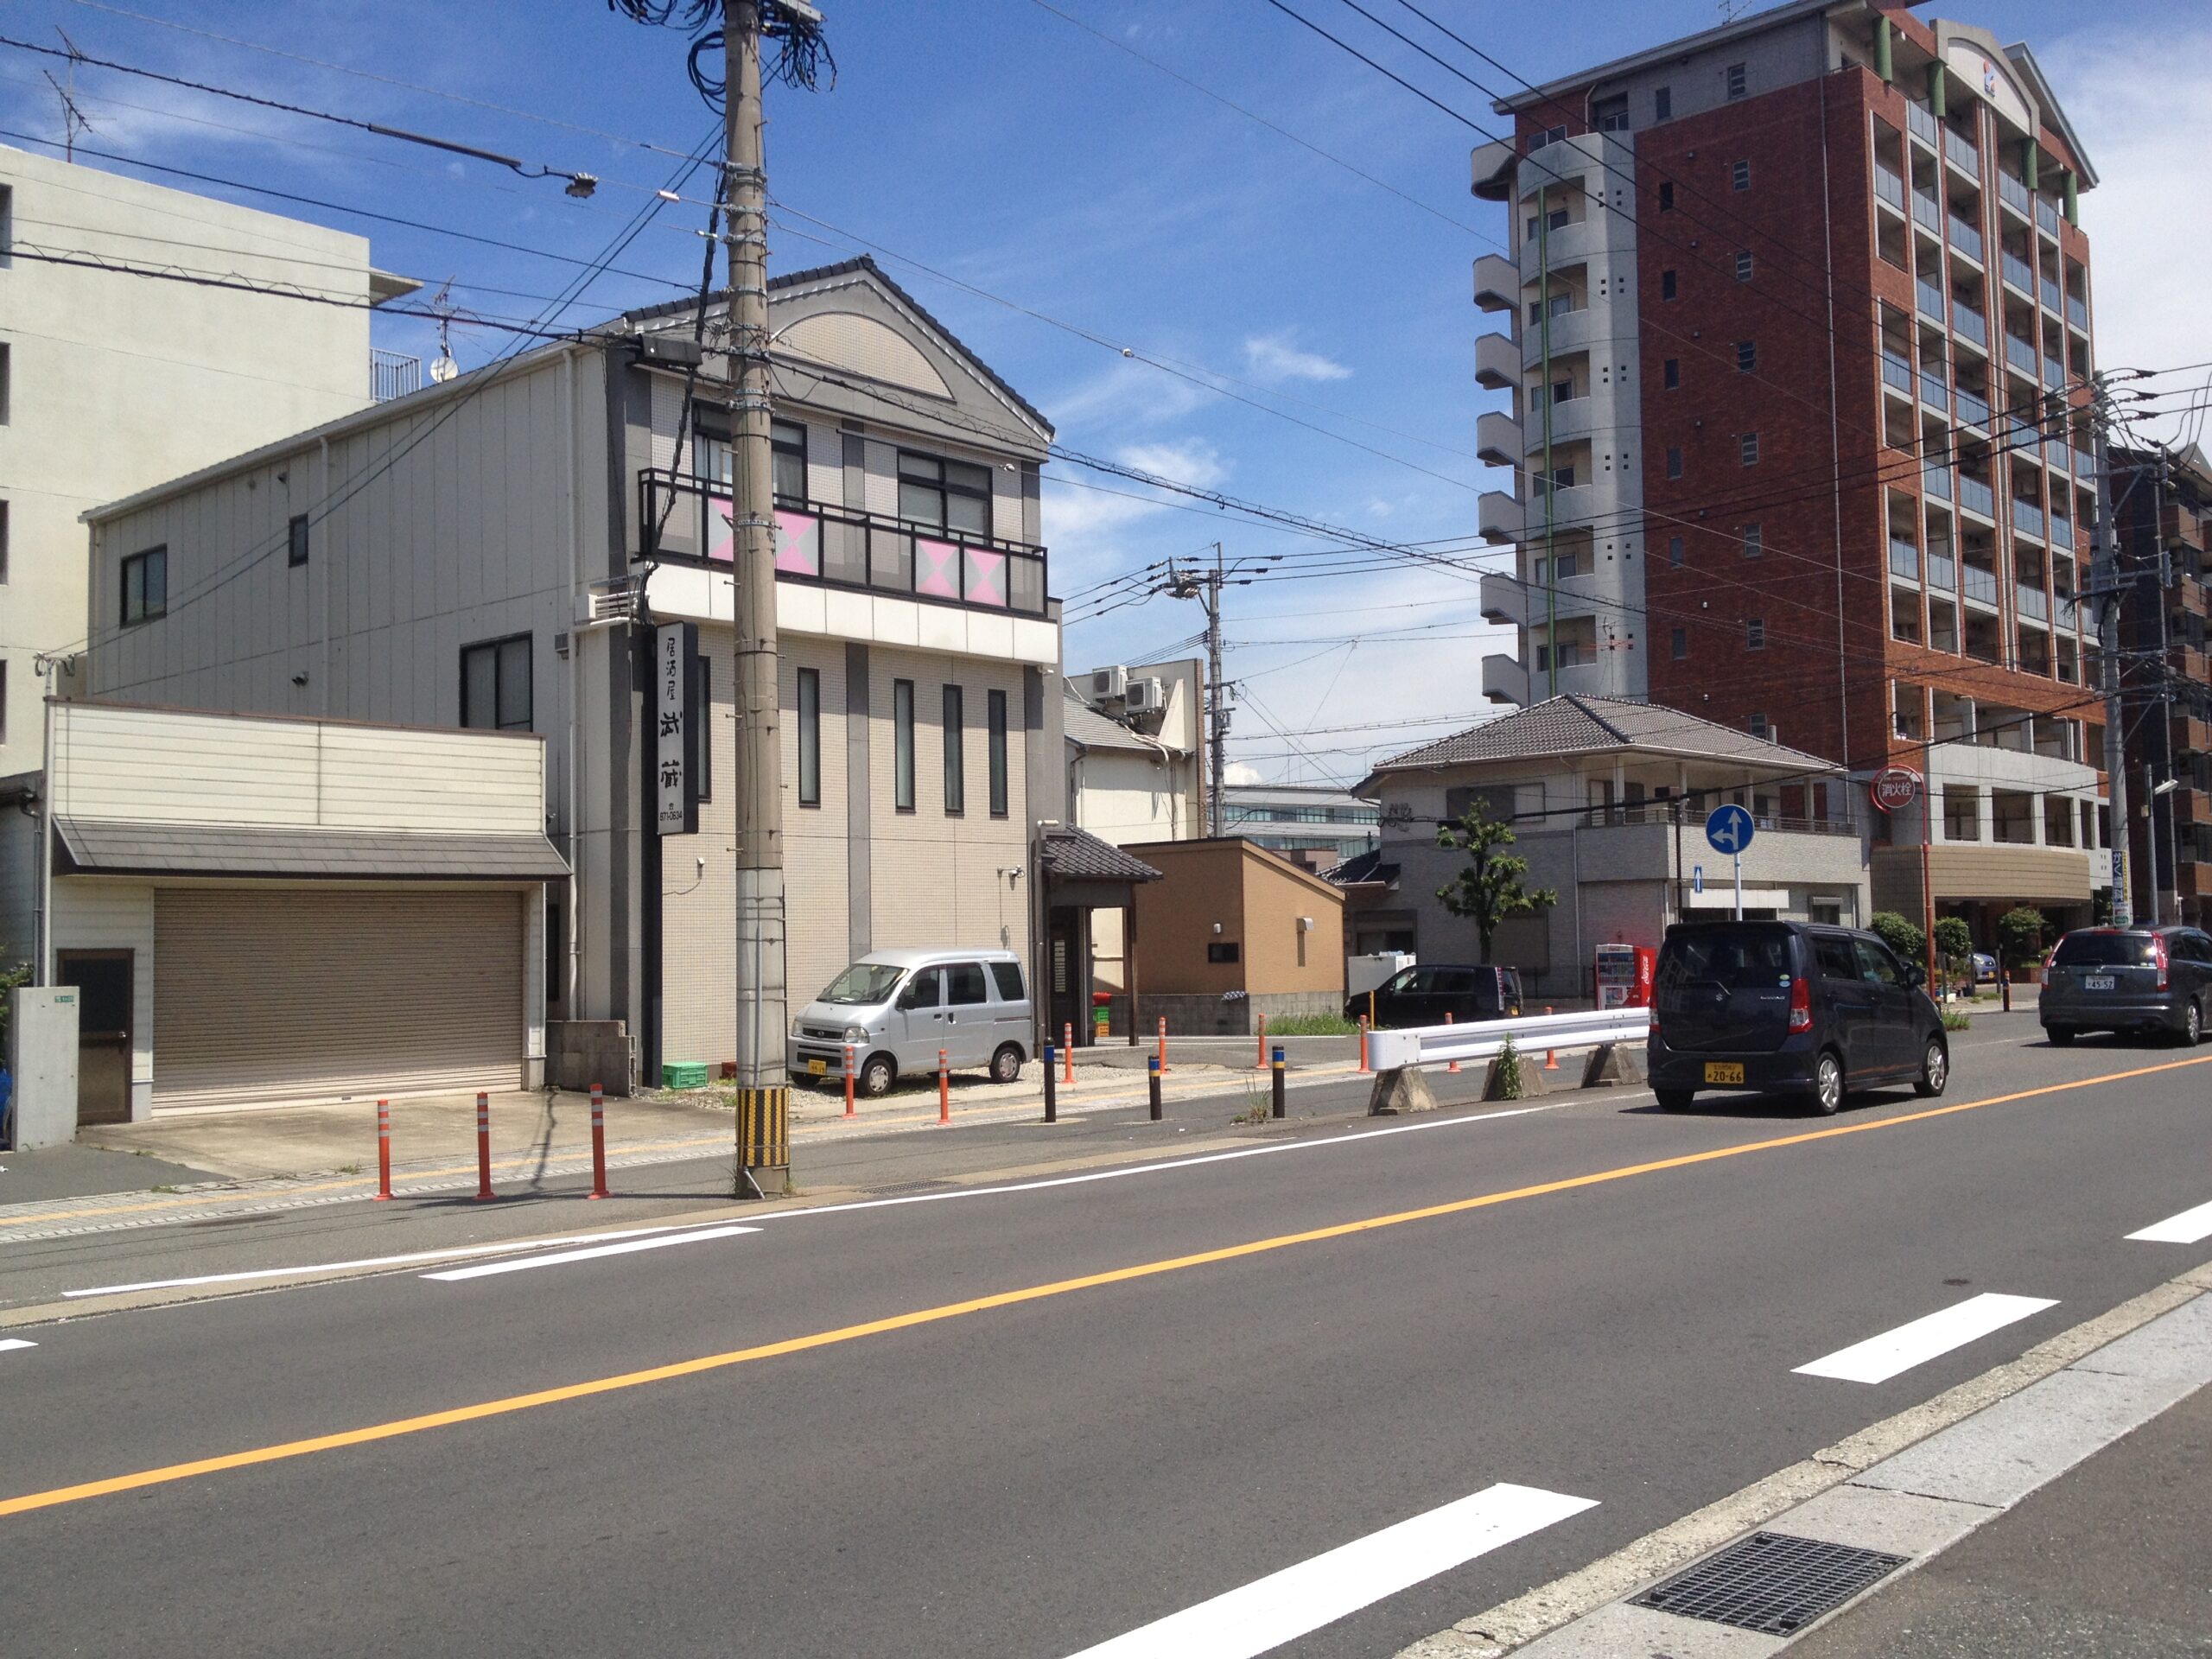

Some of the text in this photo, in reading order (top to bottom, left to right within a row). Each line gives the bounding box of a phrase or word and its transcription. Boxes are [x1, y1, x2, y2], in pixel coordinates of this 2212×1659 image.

[666, 637, 677, 701] 居酒屋
[1882, 782, 1911, 797] 消火栓
[1713, 1071, 1742, 1082] 20-66
